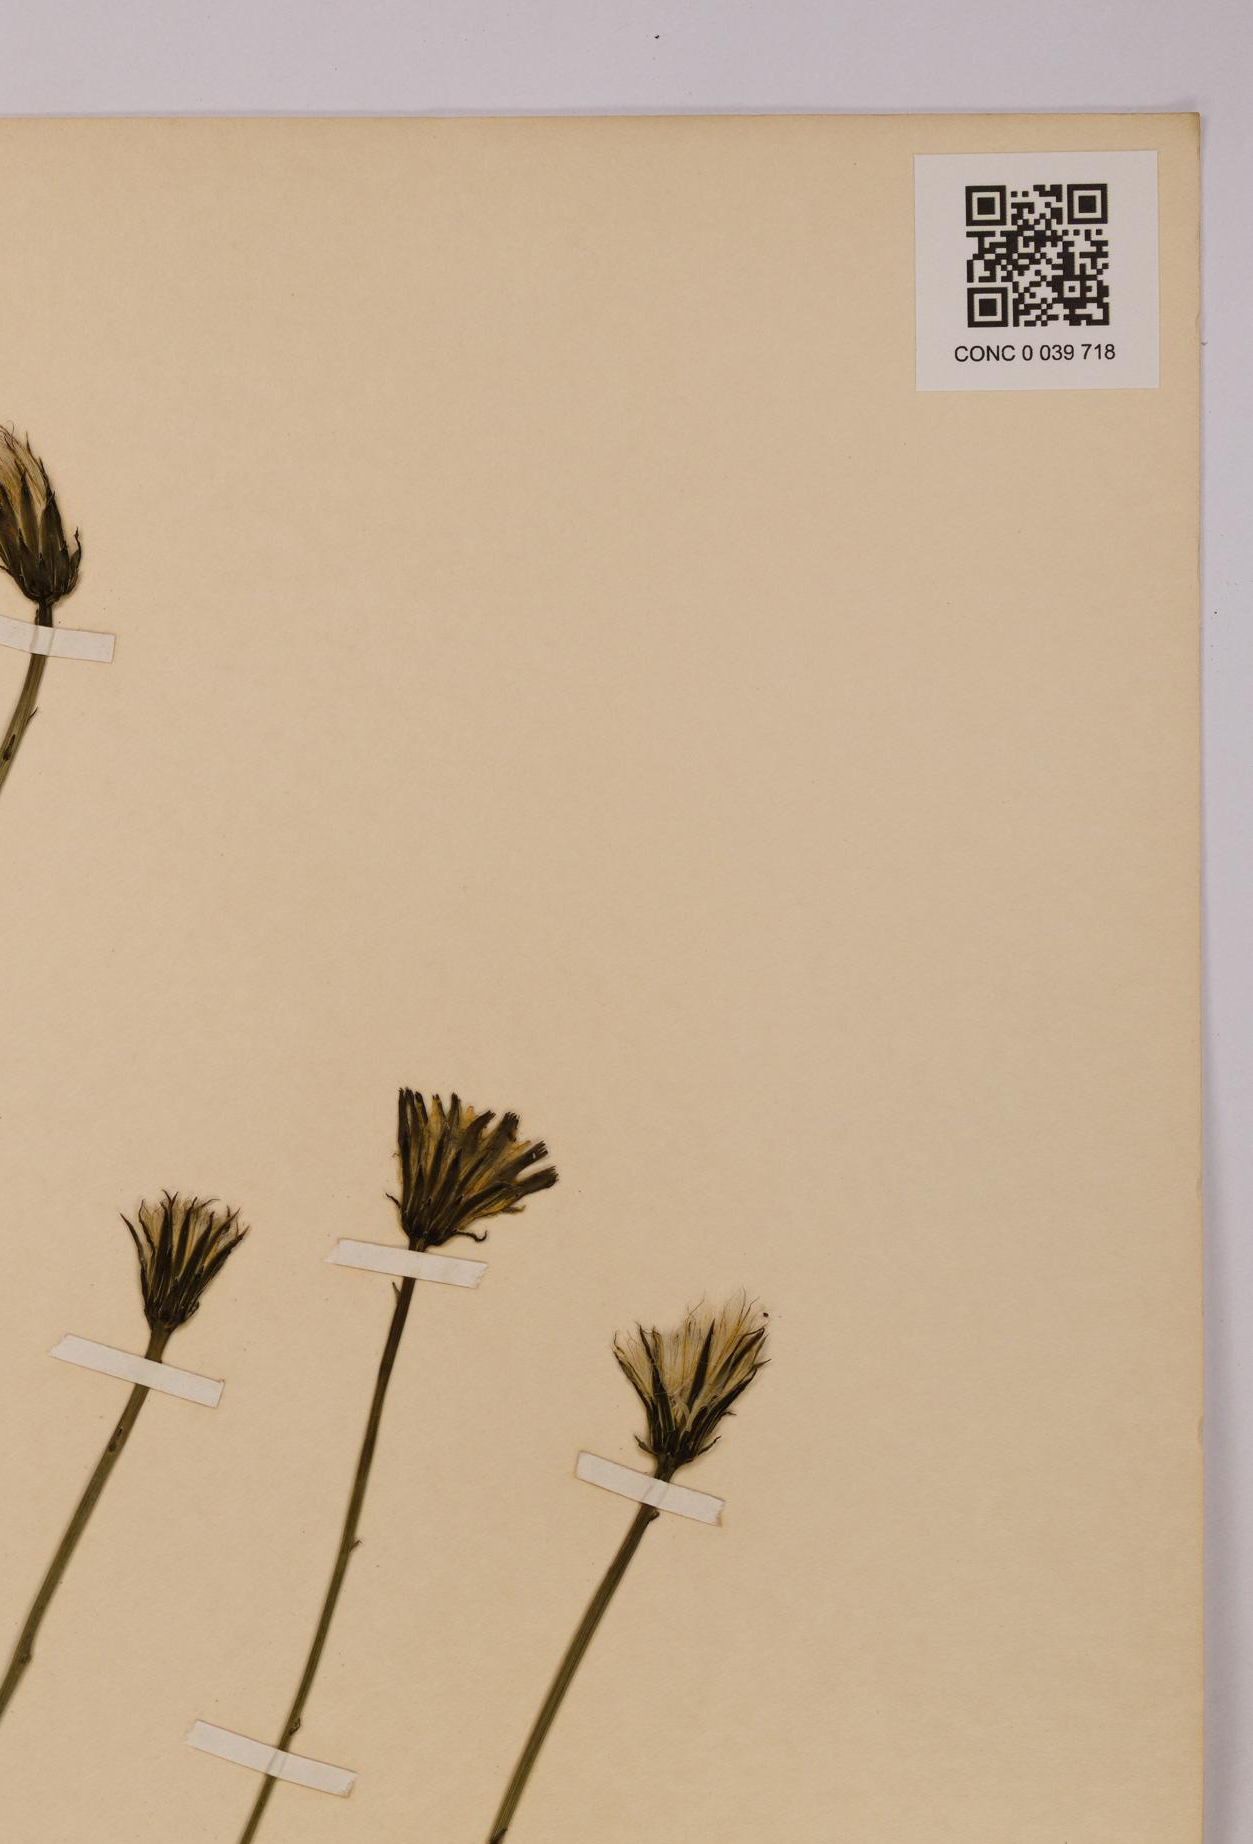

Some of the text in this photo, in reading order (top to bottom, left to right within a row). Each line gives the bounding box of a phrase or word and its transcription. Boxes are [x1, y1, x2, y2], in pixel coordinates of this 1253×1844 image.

[954, 343, 1116, 363] CONC 0 039 718
